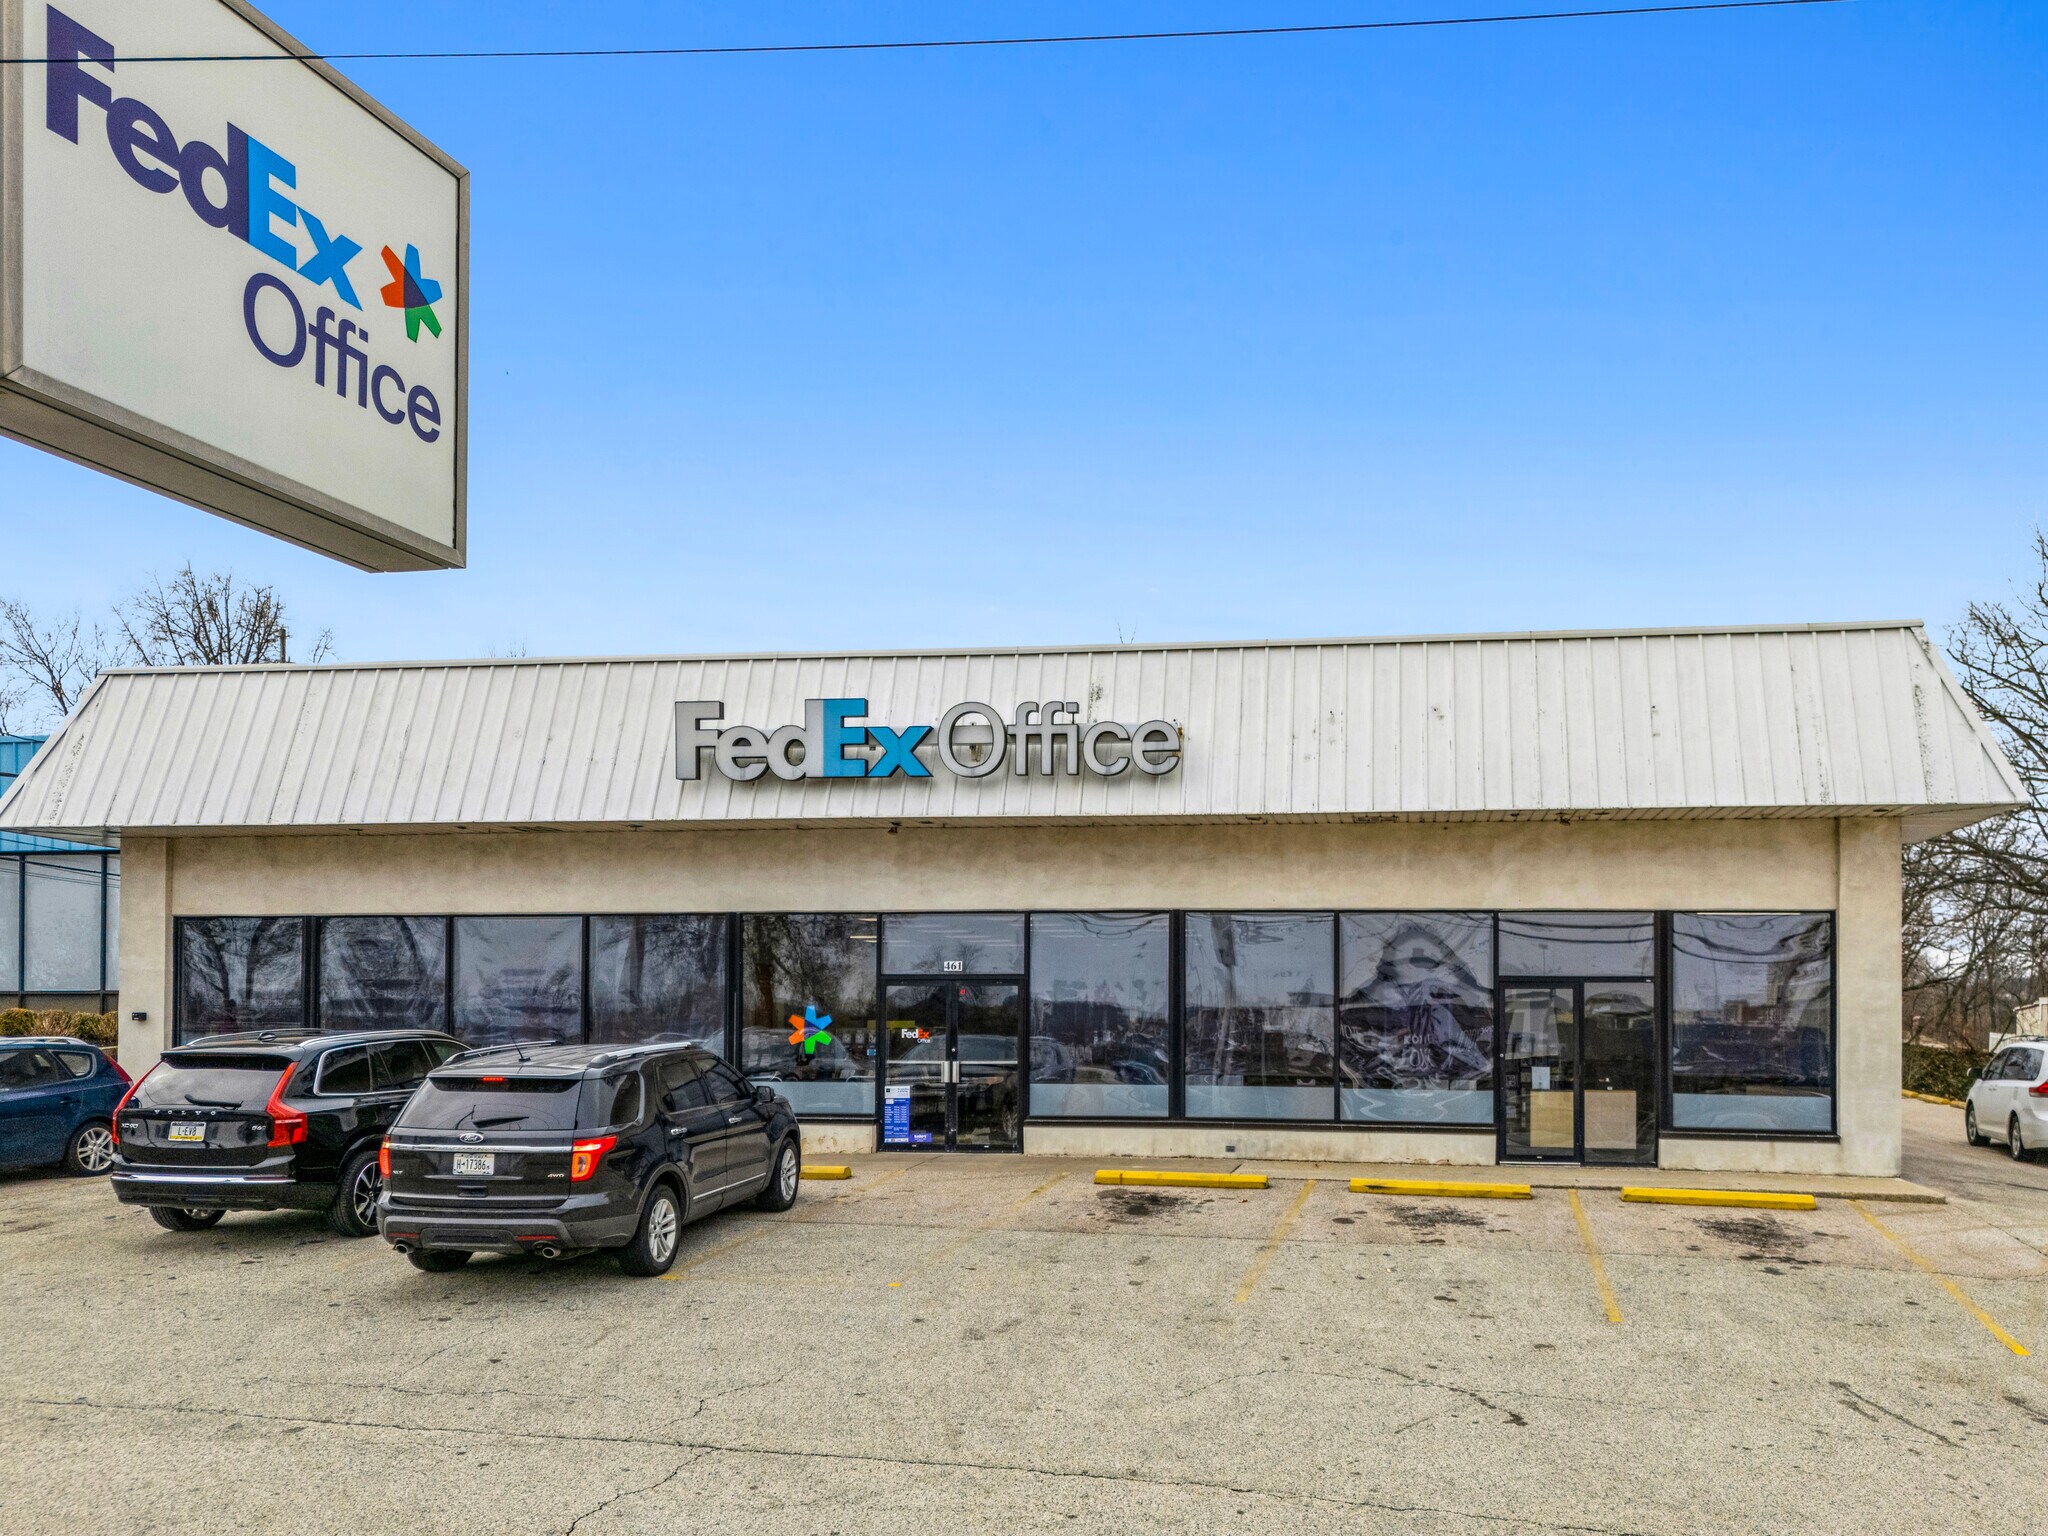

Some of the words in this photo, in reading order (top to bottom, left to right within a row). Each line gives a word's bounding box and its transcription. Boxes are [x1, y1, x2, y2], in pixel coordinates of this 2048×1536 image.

[46, 3, 363, 312] FedEx
[243, 272, 441, 443] Office
[675, 697, 934, 781] FedEx
[937, 699, 1182, 779] Office
[944, 961, 962, 970] 461
[901, 1028, 930, 1039] FedEx
